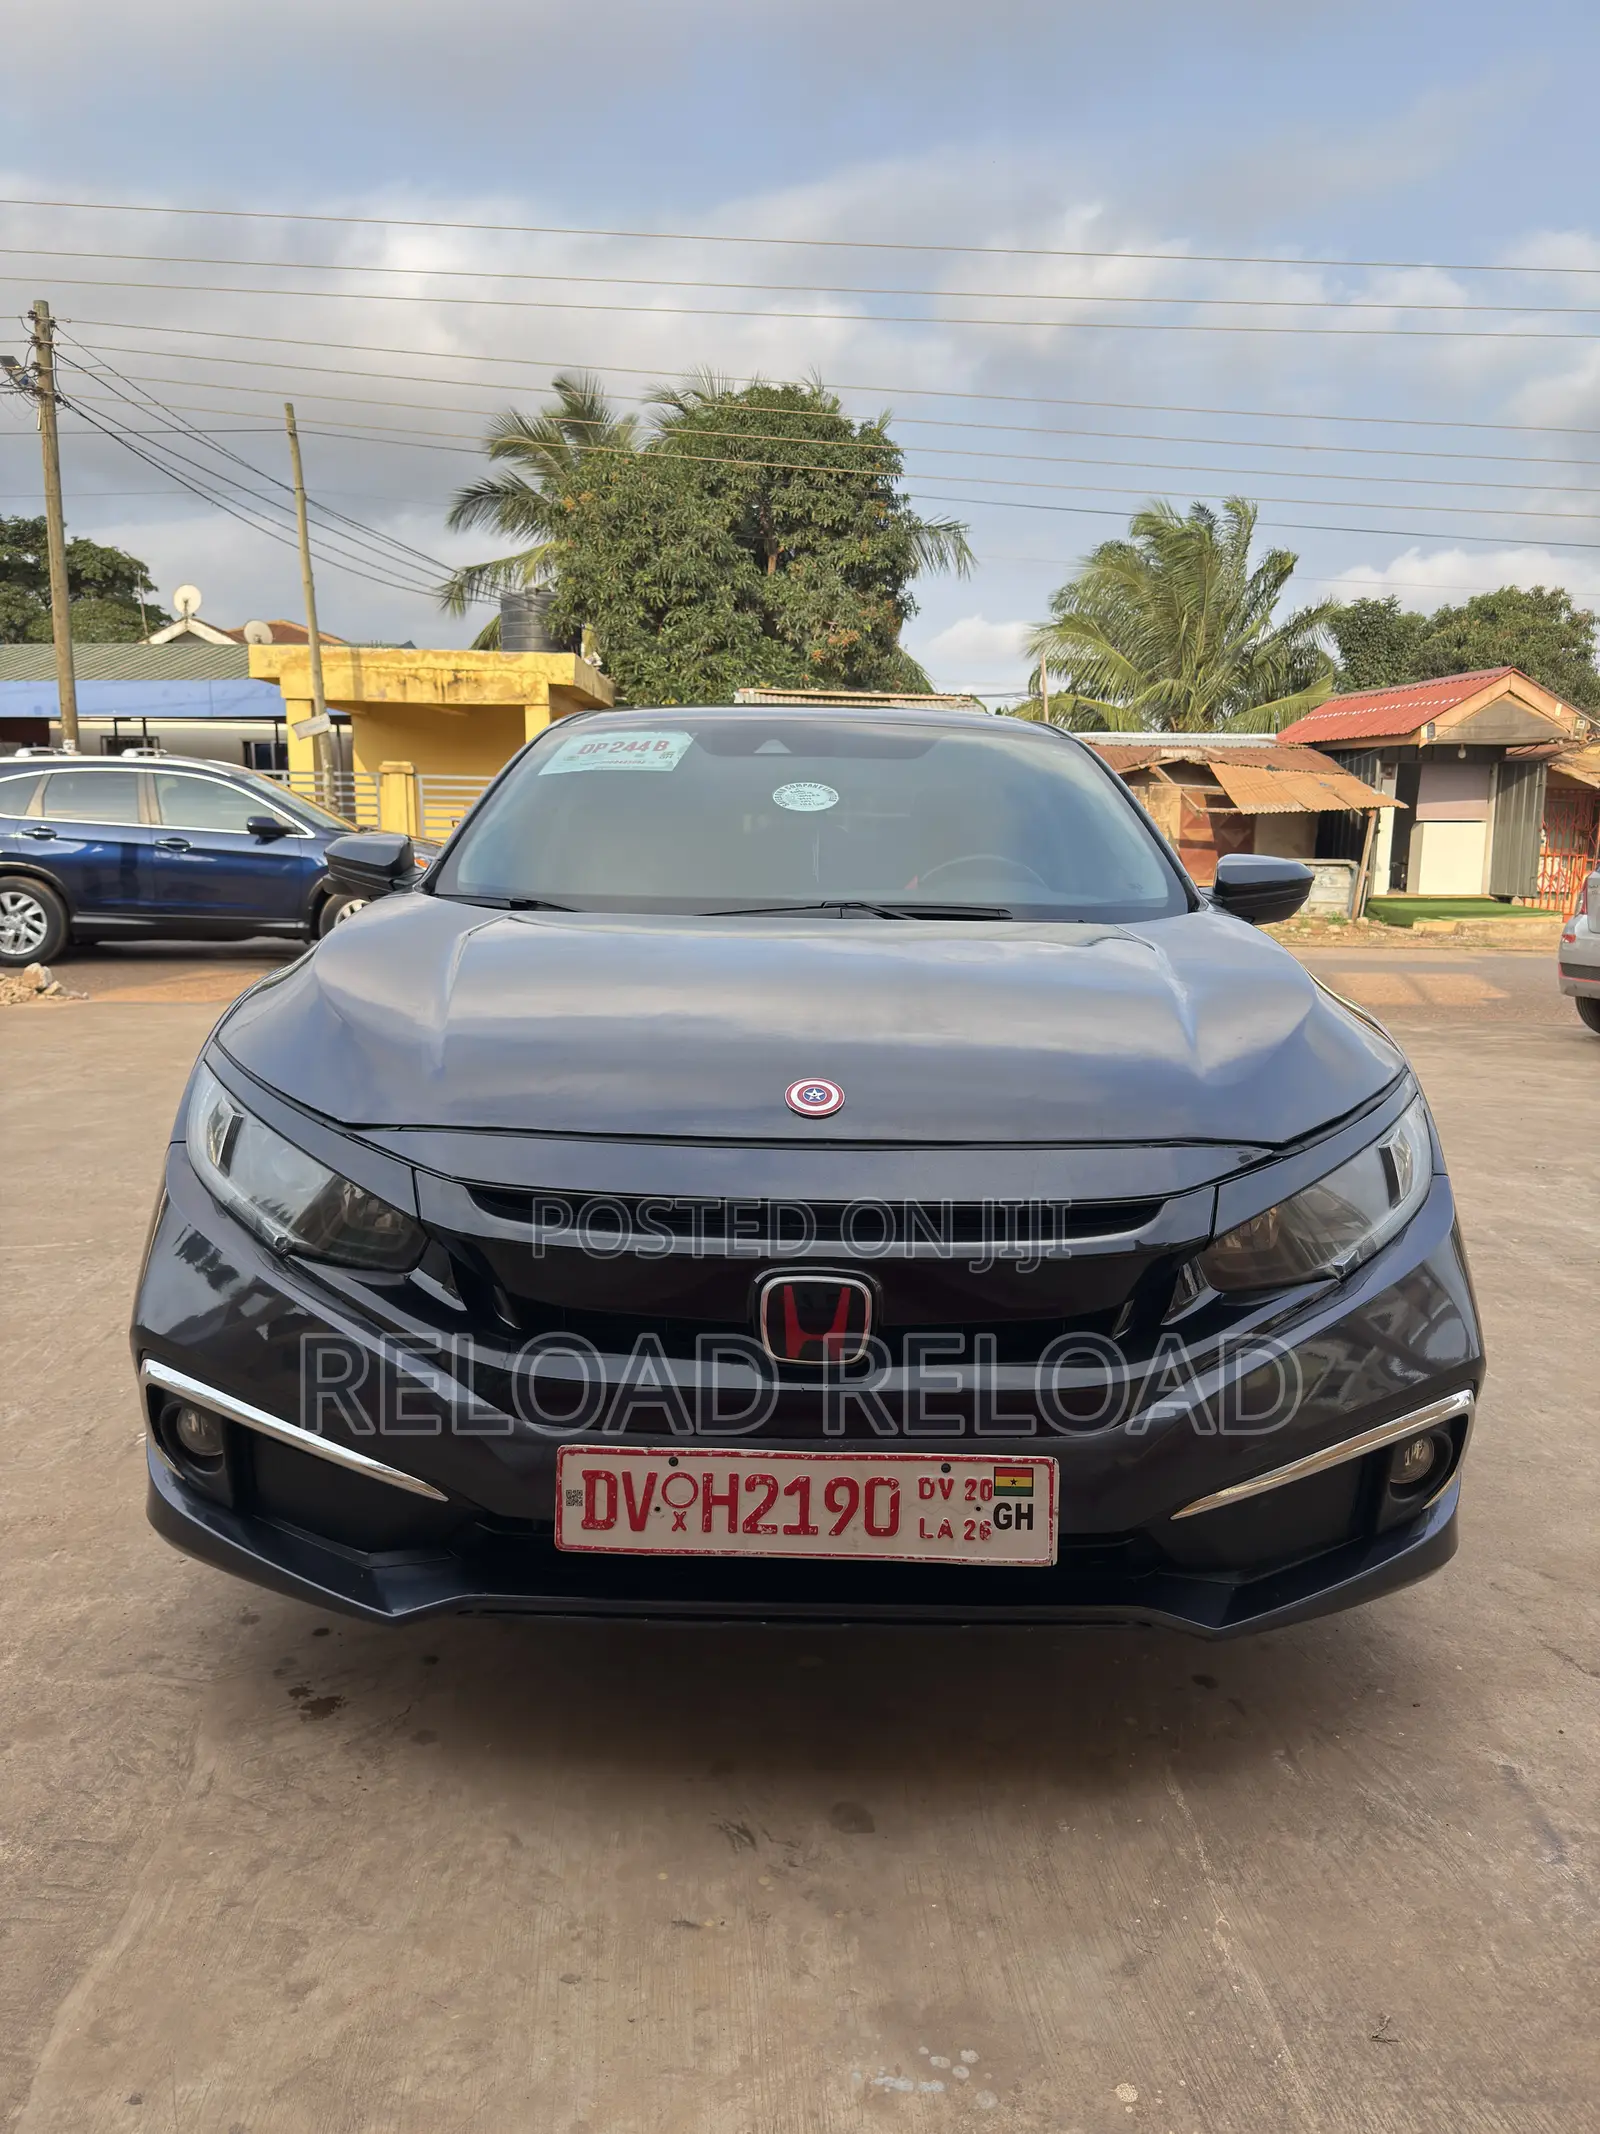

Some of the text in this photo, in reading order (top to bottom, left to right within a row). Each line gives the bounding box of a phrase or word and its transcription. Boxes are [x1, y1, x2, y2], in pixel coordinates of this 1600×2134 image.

[608, 740, 652, 754] 244
[653, 740, 670, 752] B
[581, 1469, 657, 1532] DV
[918, 1476, 994, 1501] DV 20
[993, 1502, 1034, 1531] GH
[919, 1517, 992, 1542] LA 26
